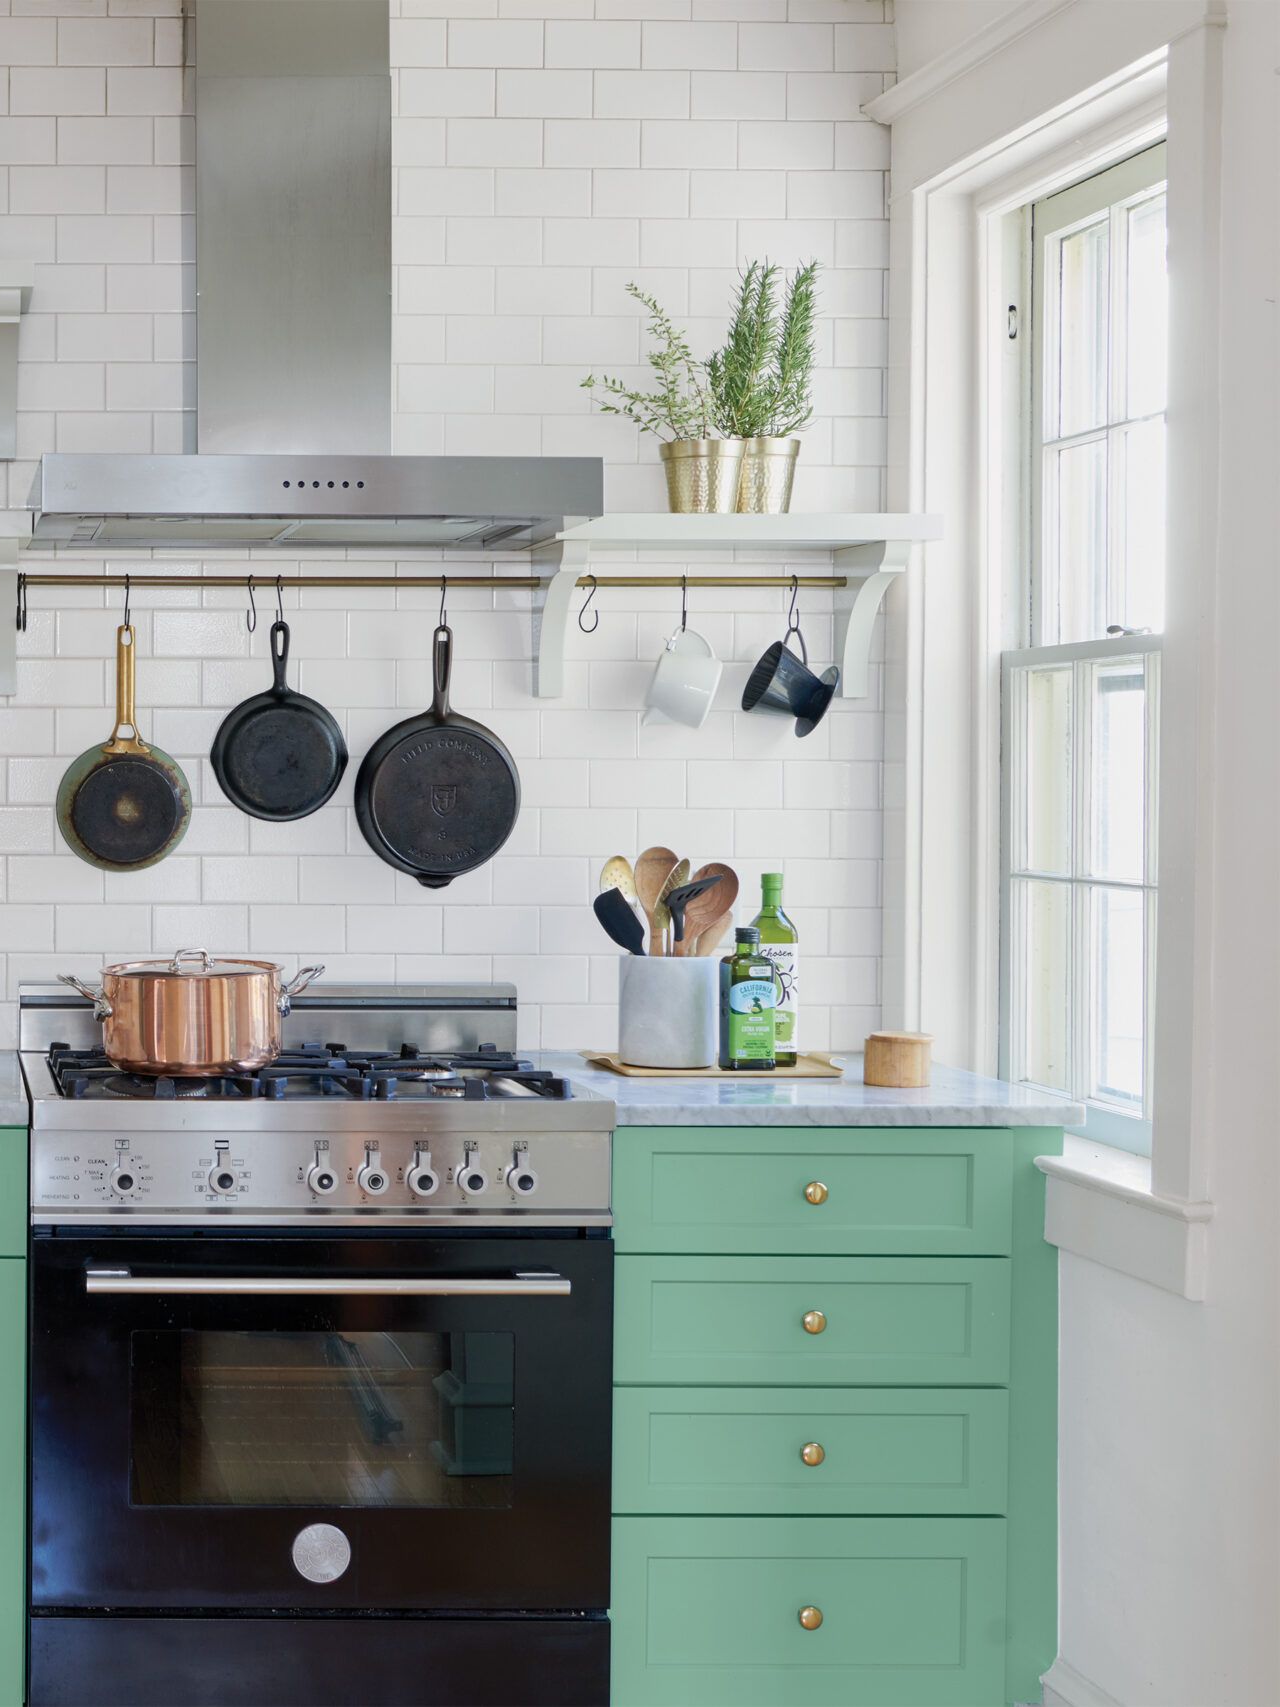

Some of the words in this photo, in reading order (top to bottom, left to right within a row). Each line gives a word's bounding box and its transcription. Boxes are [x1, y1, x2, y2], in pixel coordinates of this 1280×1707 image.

[437, 738, 490, 766] COMPANY
[457, 848, 476, 860] USA
[759, 947, 793, 957] Chosen
[740, 984, 772, 993] CALIFORNIA
